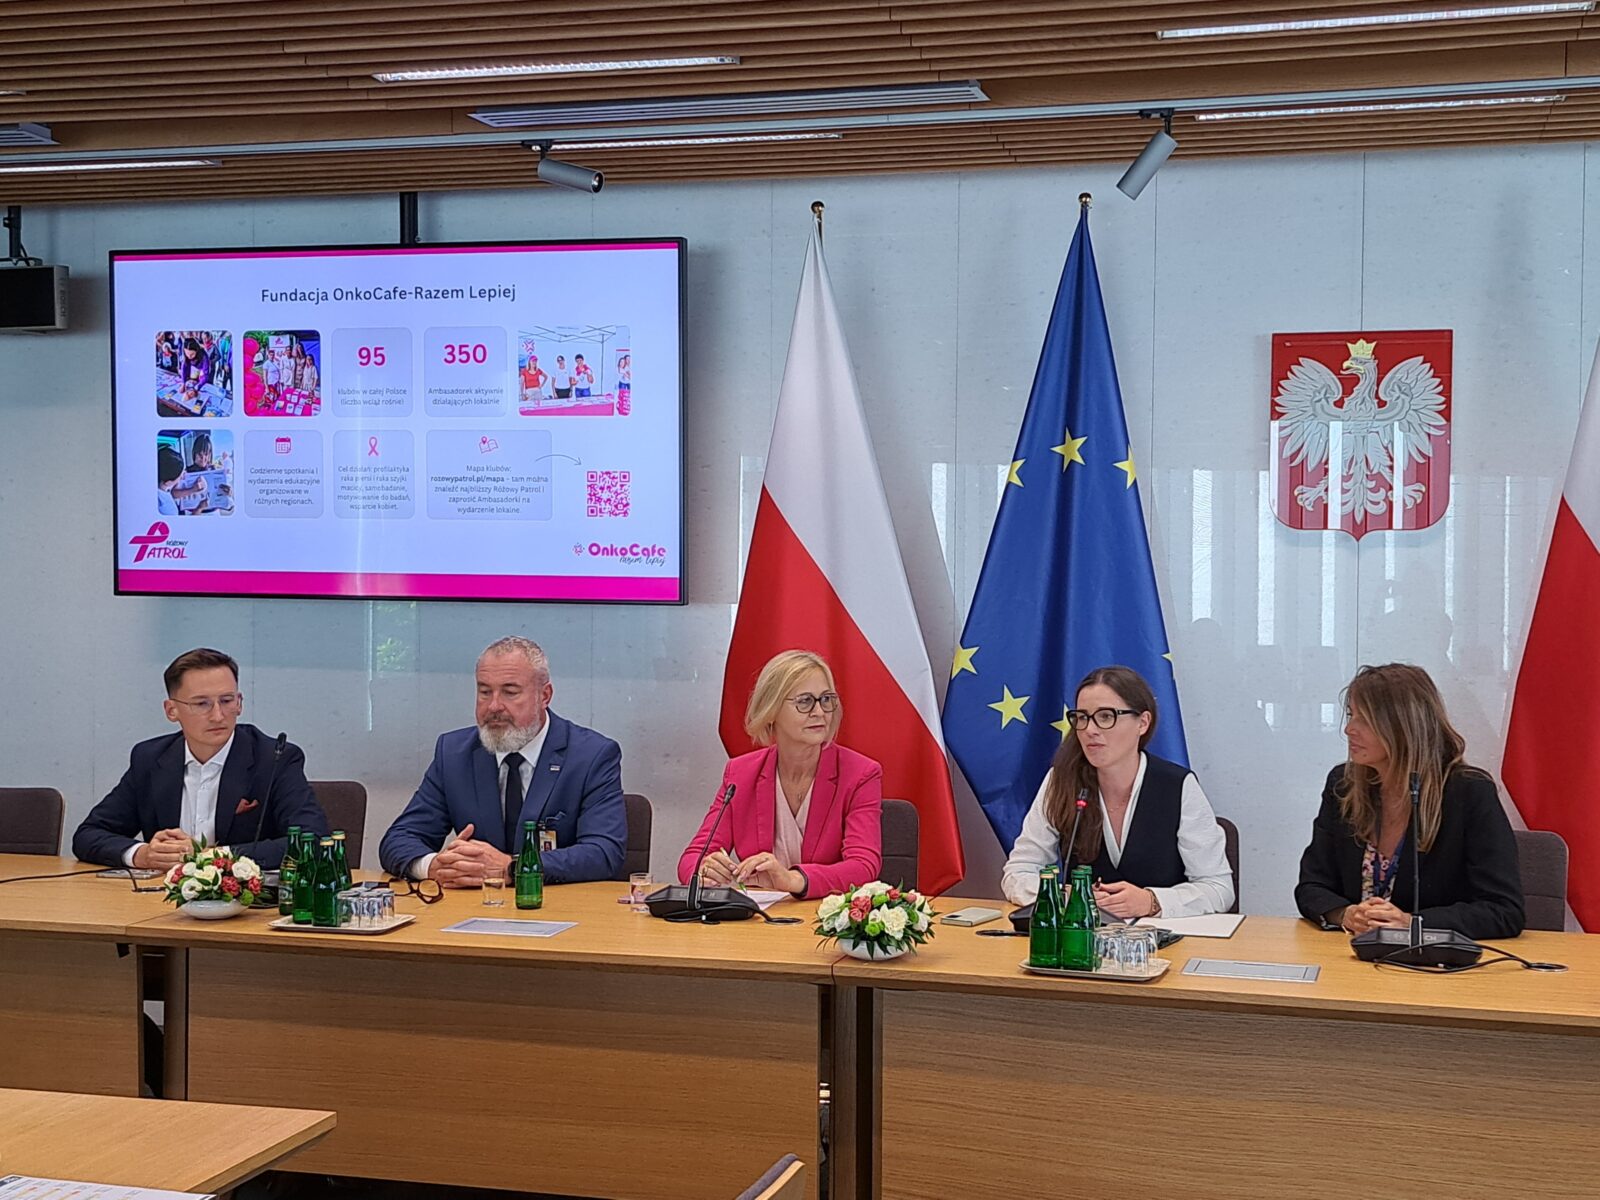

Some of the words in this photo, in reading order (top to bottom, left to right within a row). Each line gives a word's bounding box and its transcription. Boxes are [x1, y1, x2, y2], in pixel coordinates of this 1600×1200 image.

[261, 289, 329, 305] Fundacja
[333, 286, 464, 301] OnkoCafe-Razem
[469, 285, 516, 302] Lepiej
[358, 346, 386, 367] 95
[443, 344, 487, 364] 350
[428, 387, 472, 395] Ambasadorek
[475, 386, 503, 396] aktywnie
[432, 398, 472, 406] działających
[284, 467, 314, 475] spotkania
[248, 478, 283, 486] wydarzenia
[284, 478, 320, 486] edukacyjne
[430, 475, 505, 484] rozowypatrol.pl/mapa
[259, 488, 302, 496] organizowane
[493, 485, 519, 494] Różowy
[457, 506, 495, 514] wydarzenie
[588, 542, 666, 557] OnkoCafe
